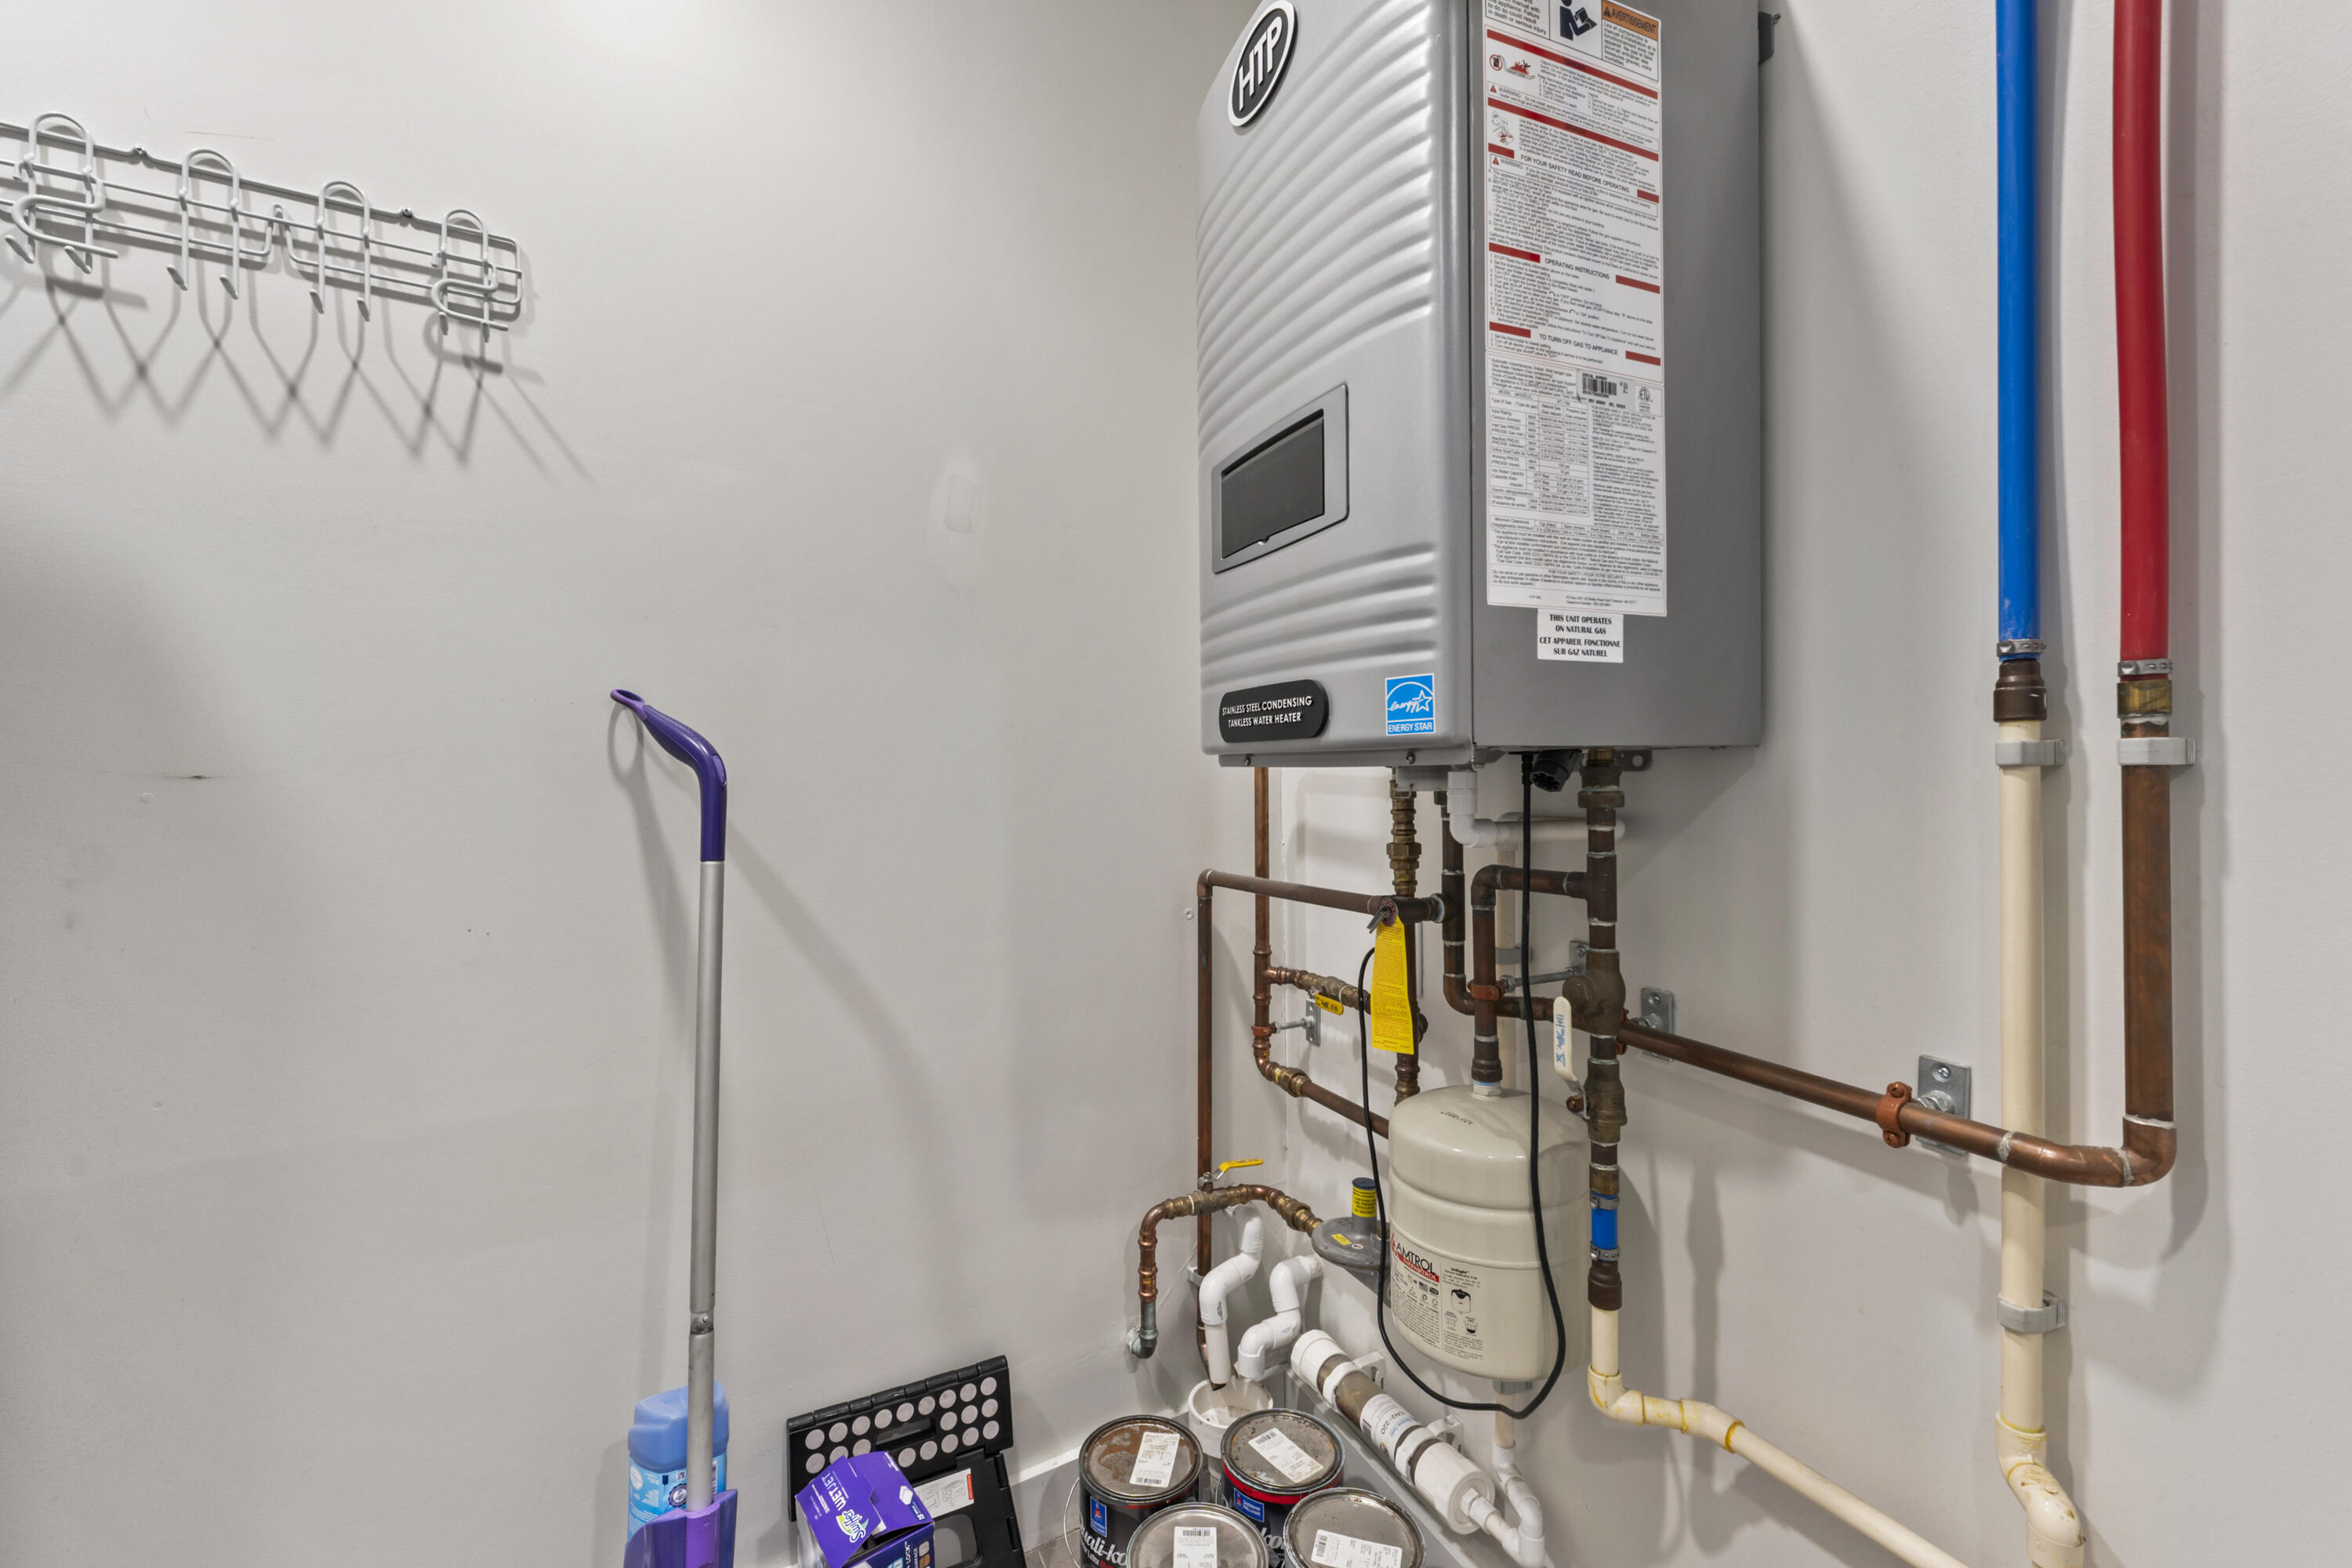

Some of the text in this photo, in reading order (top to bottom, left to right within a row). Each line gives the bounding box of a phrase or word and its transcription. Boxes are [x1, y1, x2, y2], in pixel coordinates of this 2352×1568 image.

[1612, 8, 1657, 34] AVERTISSEMENT
[1239, 16, 1283, 111] HTP
[1520, 154, 1629, 193] FOR YOUR SAFETY READ BEFORE OPERATING
[1544, 258, 1573, 270] OPERATING
[1574, 265, 1609, 279] INSTRUCTIONS
[1592, 344, 1617, 355] APPLIANCE
[1549, 614, 1564, 622] THIS
[1581, 616, 1612, 625] OPERATES
[1553, 637, 1583, 646] APPAREIL
[1584, 638, 1621, 648] FONCTIONNE
[1222, 695, 1313, 716] STAINLESS STEEL CONDENSING
[1228, 712, 1301, 728] TANKLESS WATER HEATER
[1388, 721, 1432, 733] ENERGY STAR
[1396, 1243, 1436, 1275] AMTROL
[1381, 1411, 1405, 1435] CN2-220
[822, 1473, 847, 1511] WETJET
[841, 1508, 866, 1544] Swiffer
